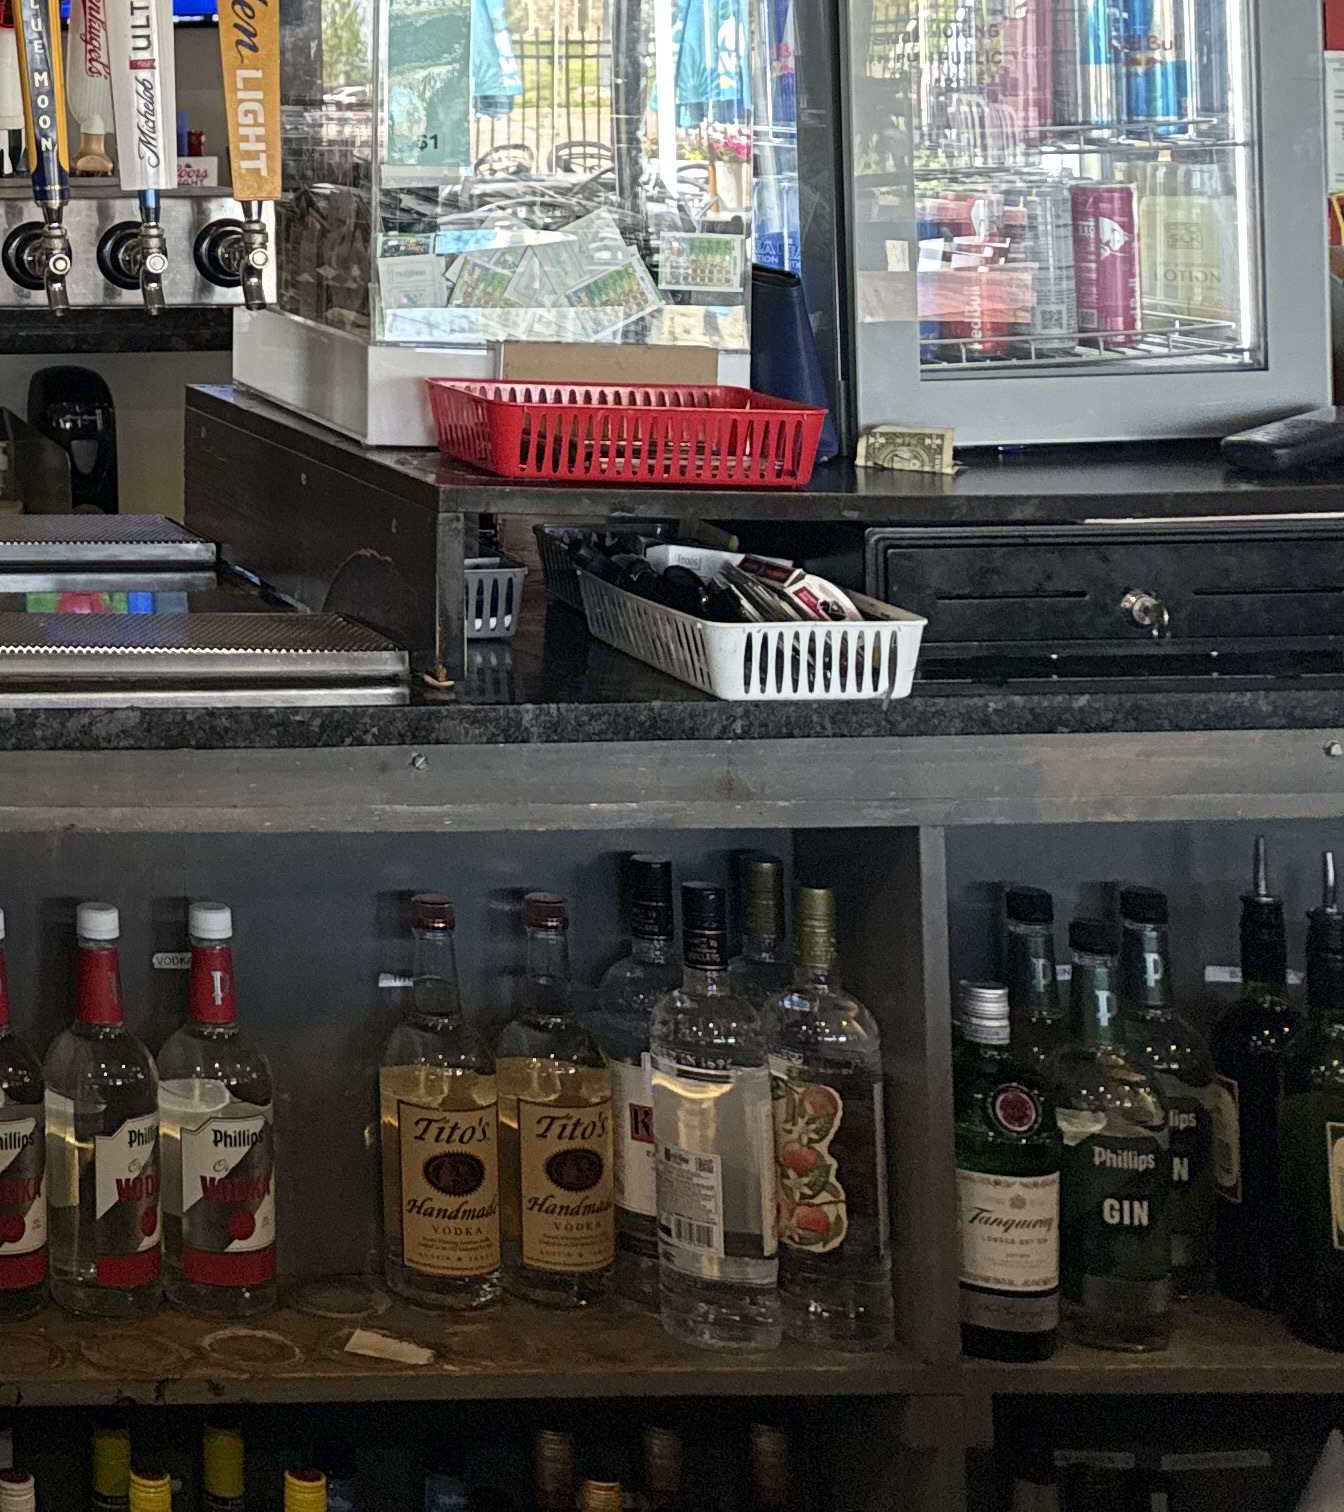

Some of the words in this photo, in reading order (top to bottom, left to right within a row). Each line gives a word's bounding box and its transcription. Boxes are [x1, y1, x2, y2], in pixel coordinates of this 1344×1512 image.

[32, 71, 54, 151] MOON
[136, 77, 161, 169] Michelob
[234, 68, 267, 177] LIGHT
[213, 1128, 265, 1149] Phillips
[413, 1115, 491, 1145] Tito's
[535, 1112, 608, 1142] Tito's
[1093, 1146, 1156, 1173] Phillips
[1102, 1197, 1150, 1228] GIN
[431, 1224, 484, 1237] VODKA
